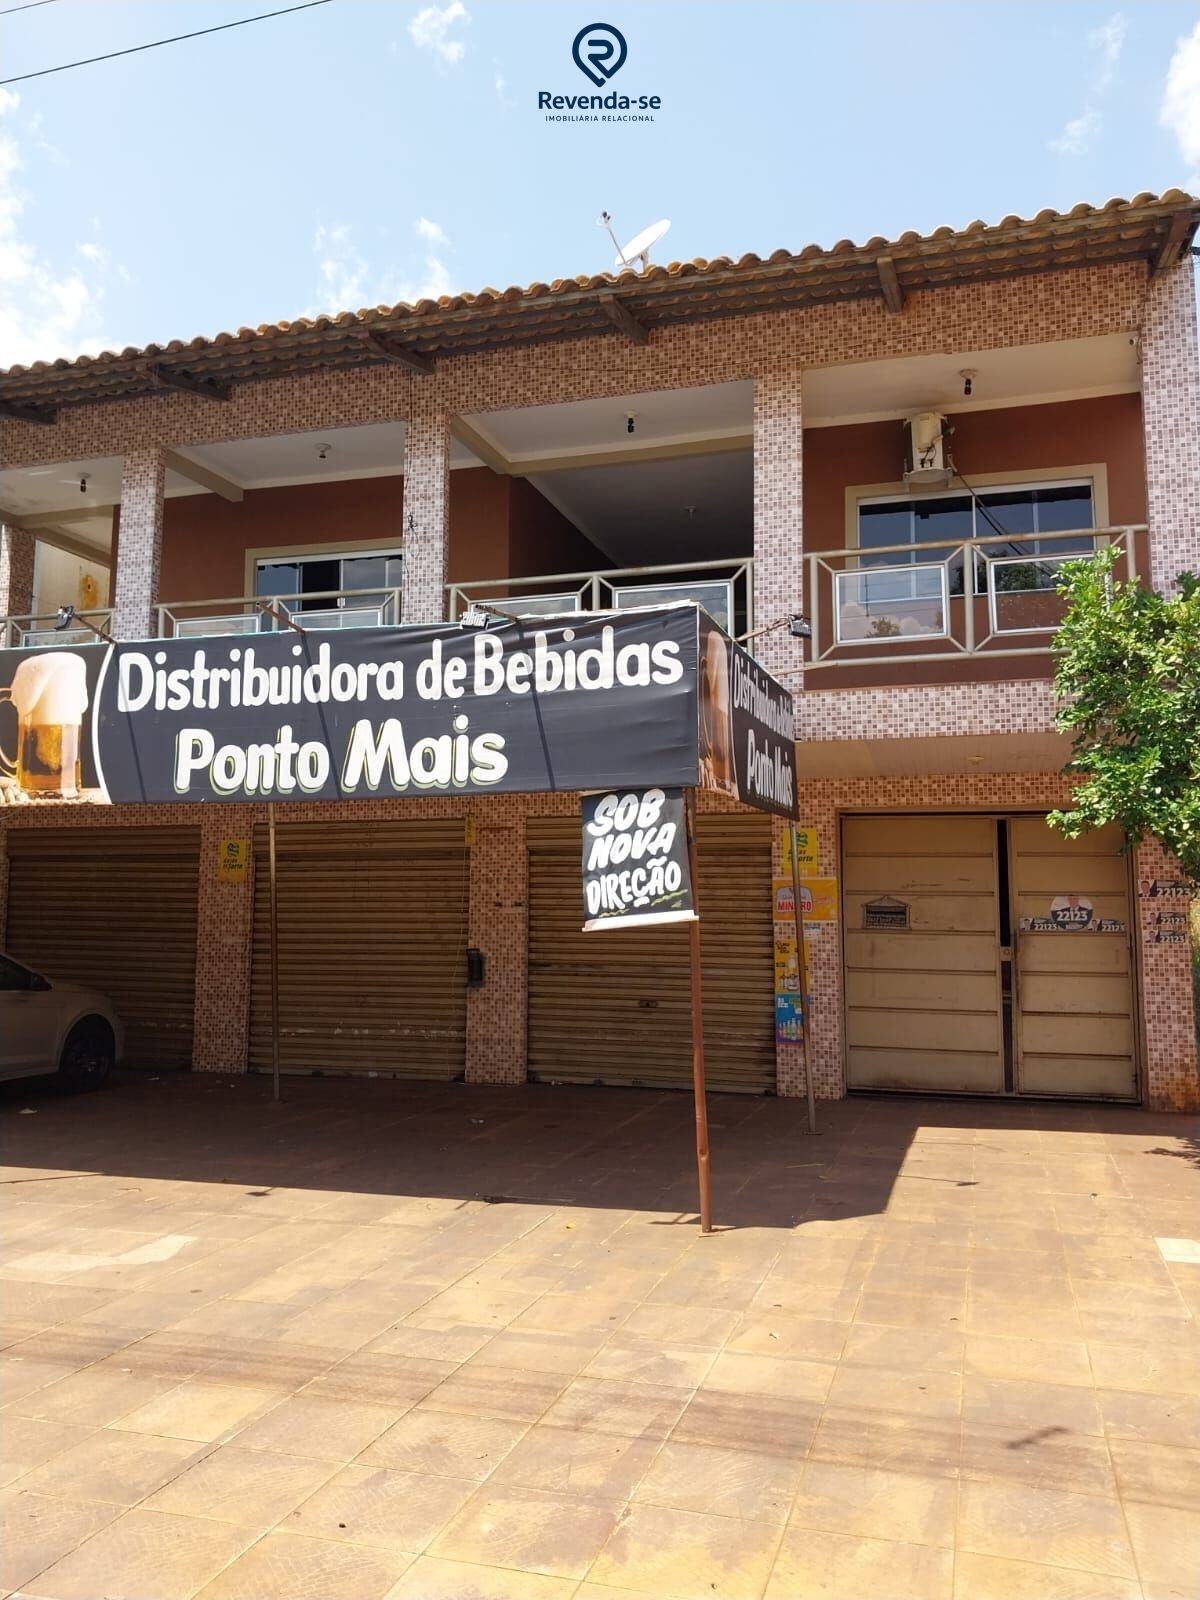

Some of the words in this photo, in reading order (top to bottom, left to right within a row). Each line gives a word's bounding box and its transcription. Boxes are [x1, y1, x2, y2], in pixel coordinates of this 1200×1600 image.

[118, 642, 404, 713] Distribuidora
[416, 638, 467, 700] de
[474, 625, 684, 696] Bebidas
[174, 725, 330, 796] Ponto
[340, 715, 509, 793] Mais
[747, 729, 774, 799] Ponto
[774, 746, 793, 808] Mais
[586, 788, 666, 836] SOB
[587, 822, 677, 871] NOVA
[586, 855, 682, 915] DIREÇÃO
[777, 900, 812, 911] MINRO
[1034, 923, 1058, 931] 22123
[1056, 911, 1088, 921] 22123
[1159, 935, 1185, 943] 22123
[1160, 917, 1185, 925] 22123
